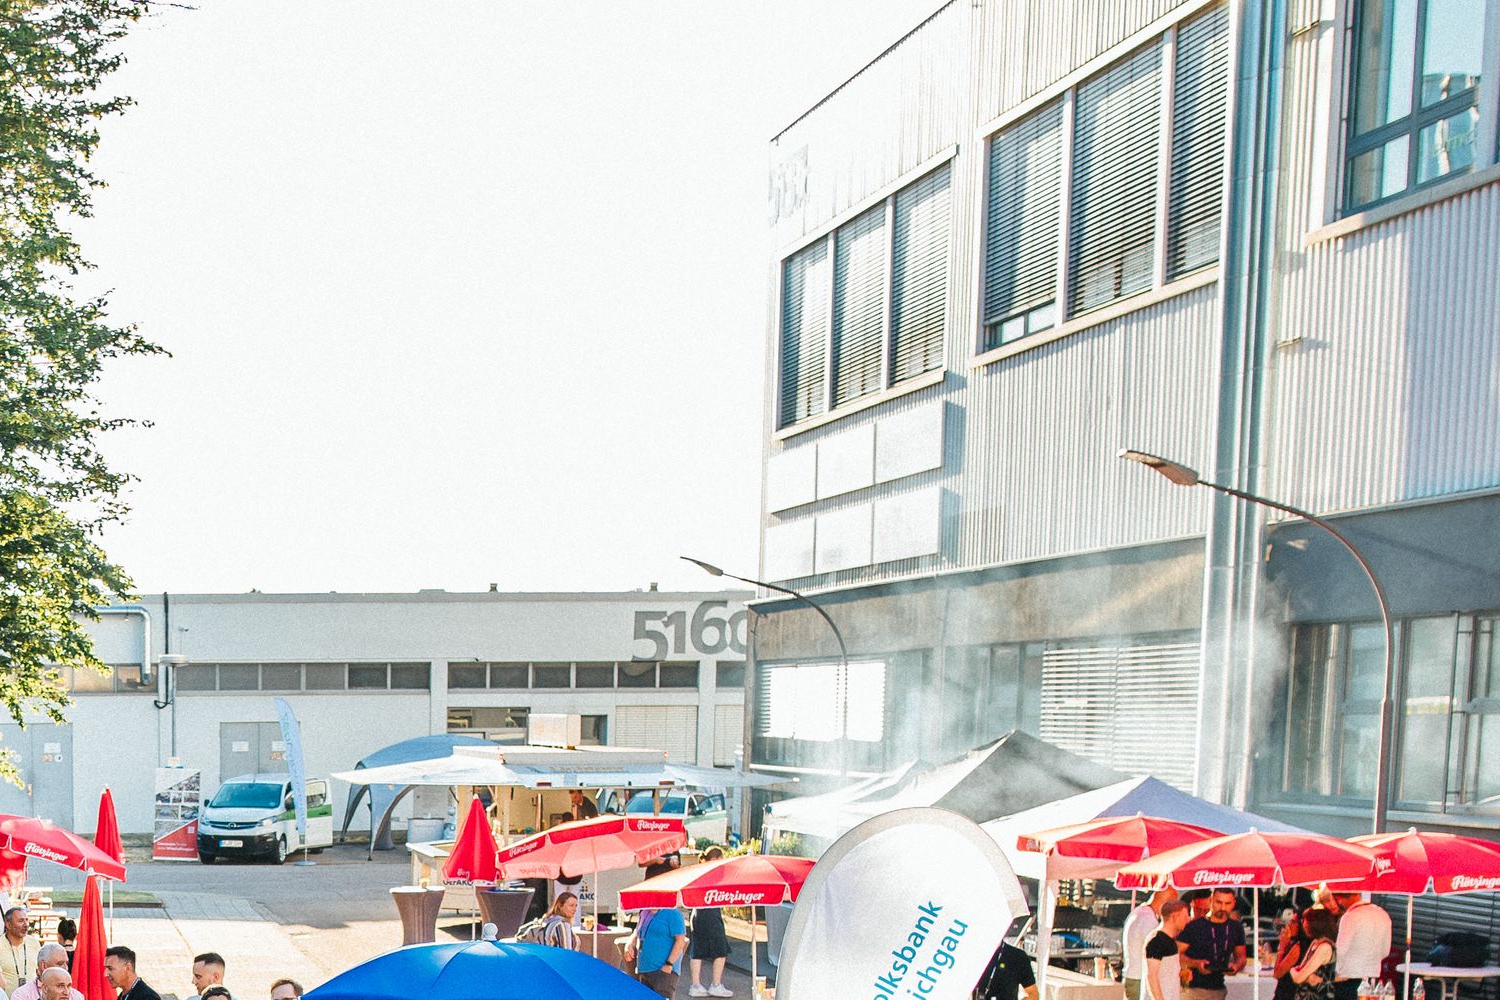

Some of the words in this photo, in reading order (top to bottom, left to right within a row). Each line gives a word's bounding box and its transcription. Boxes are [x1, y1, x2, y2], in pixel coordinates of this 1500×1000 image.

[24, 842, 68, 862] Flötzinger
[1193, 869, 1255, 885] Flötzinger
[704, 889, 765, 904] Flötzinger
